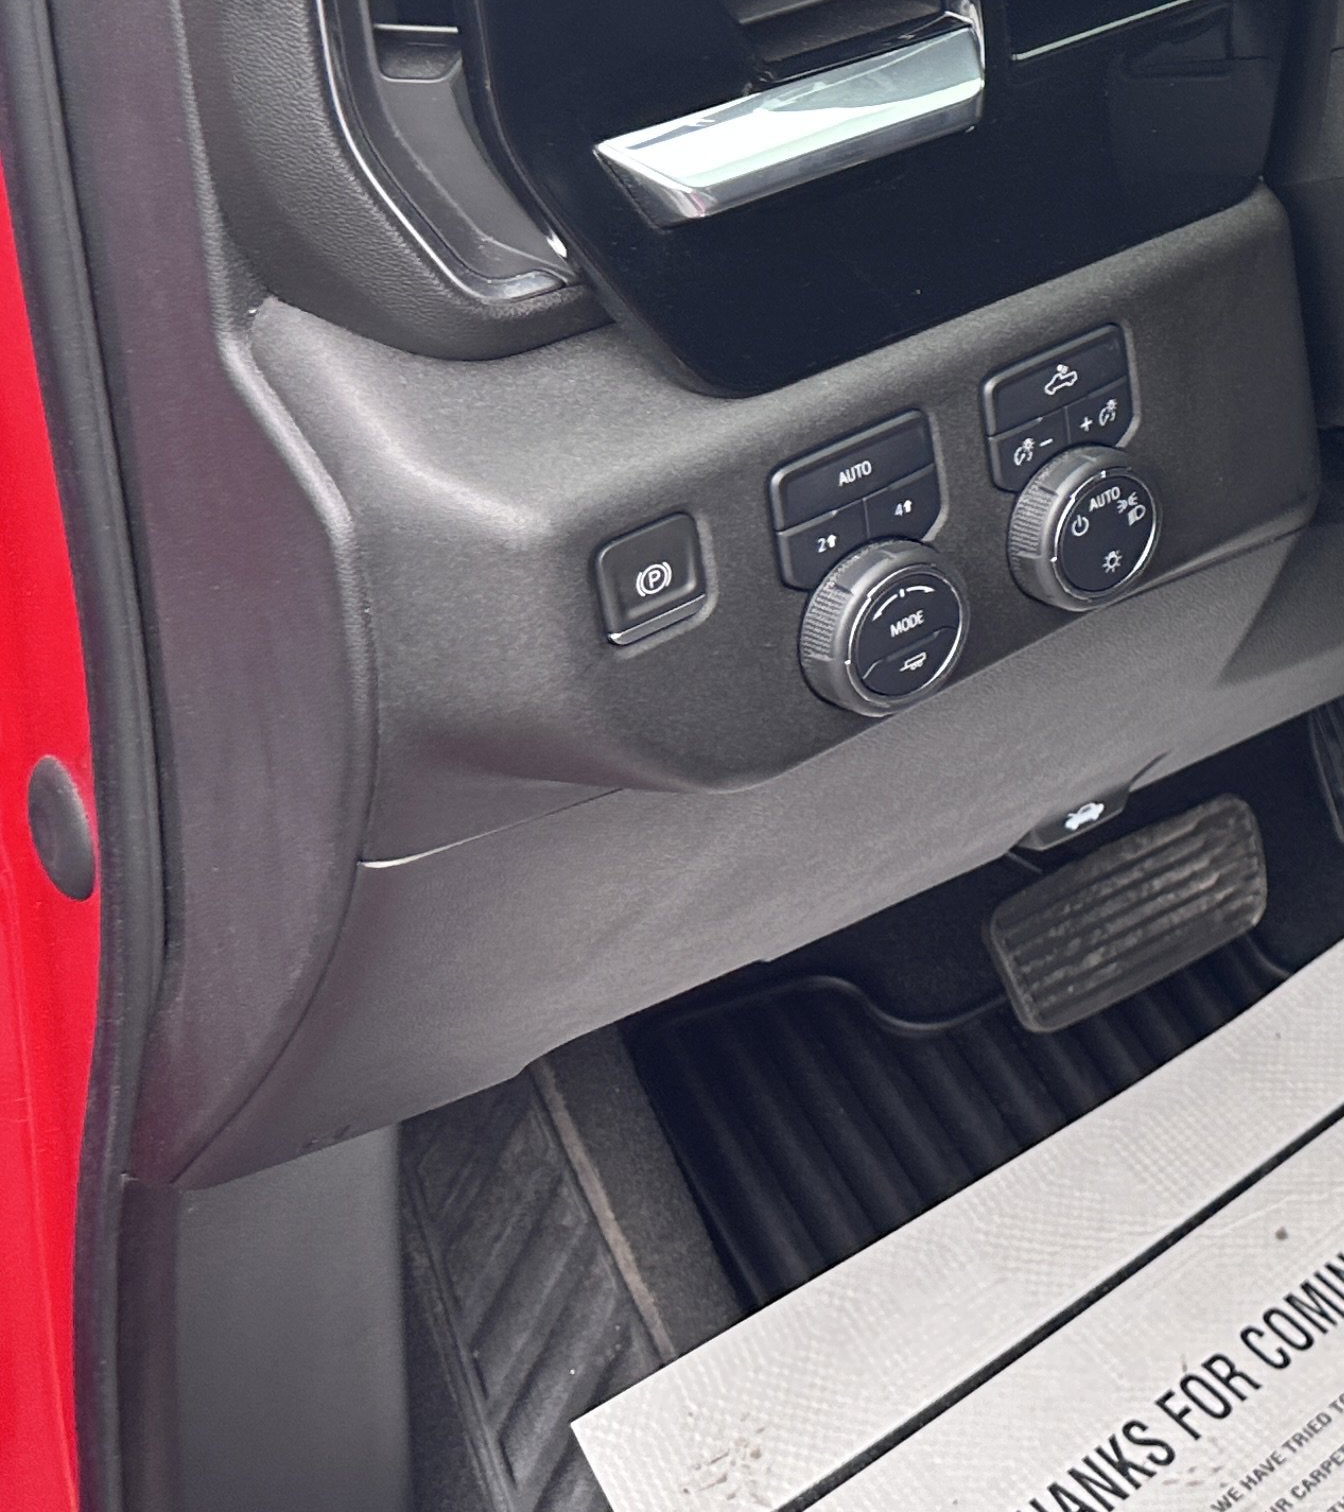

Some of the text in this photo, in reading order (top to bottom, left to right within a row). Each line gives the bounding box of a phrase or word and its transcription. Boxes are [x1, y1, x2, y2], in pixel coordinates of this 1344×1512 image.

[838, 460, 873, 486] AUTO
[1089, 486, 1121, 512] AUTO
[889, 609, 925, 638] MODE
[1016, 1419, 1175, 1512] ANKS
[1155, 1353, 1262, 1441] FOR
[1210, 1486, 1245, 1512] WE
[1239, 1450, 1288, 1491] HAVE
[1281, 1412, 1333, 1454] TRIED
